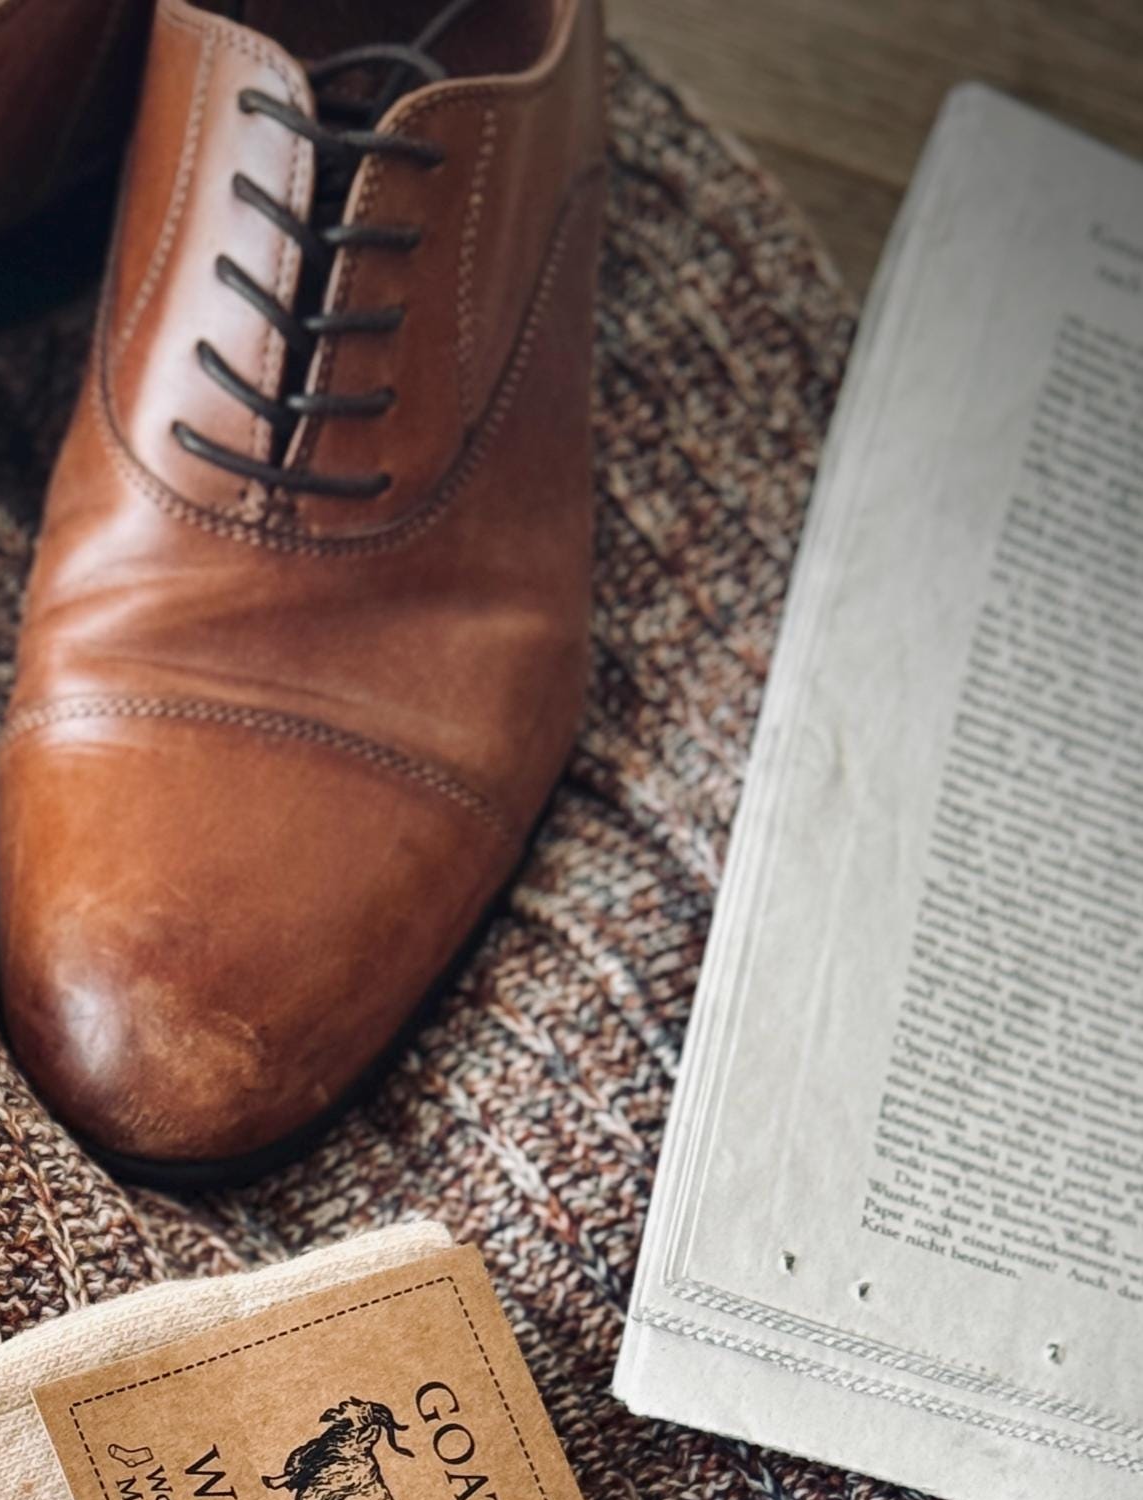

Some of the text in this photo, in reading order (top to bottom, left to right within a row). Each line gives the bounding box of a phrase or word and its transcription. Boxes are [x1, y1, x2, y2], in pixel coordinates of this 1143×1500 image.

[894, 1169, 924, 1191] Das
[863, 1196, 904, 1222] Papst
[914, 1218, 953, 1239] noch
[861, 1215, 1022, 1280] Krise nicht beenden.
